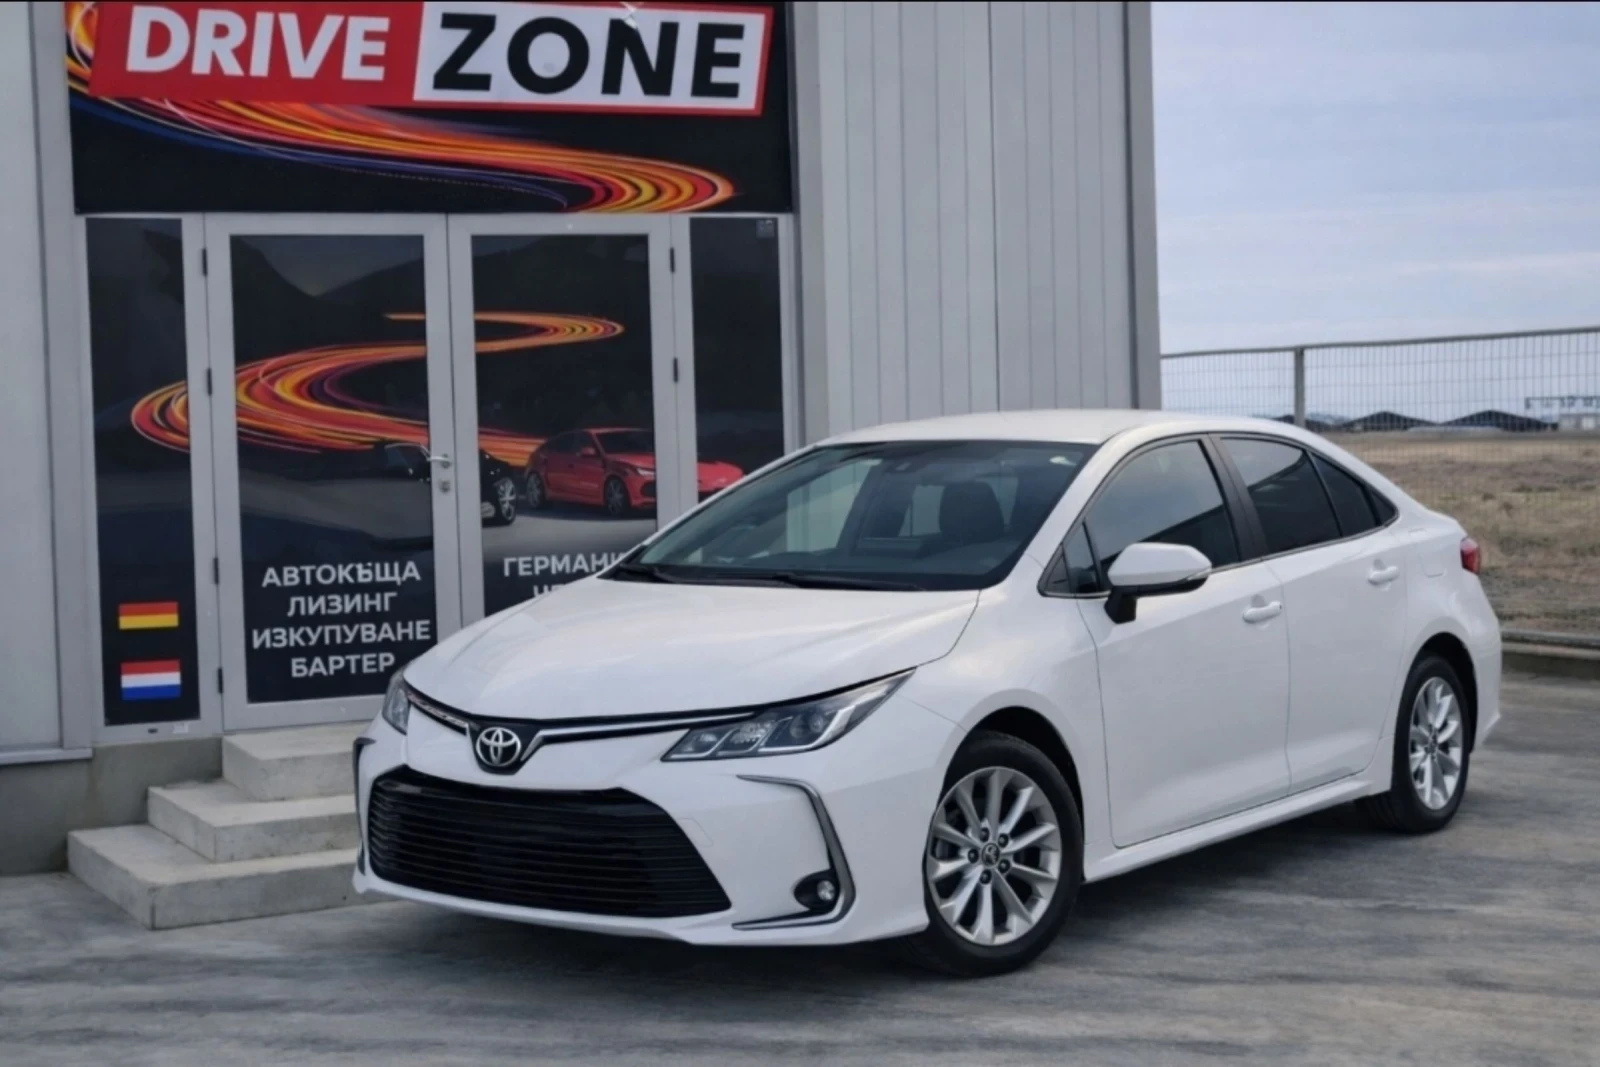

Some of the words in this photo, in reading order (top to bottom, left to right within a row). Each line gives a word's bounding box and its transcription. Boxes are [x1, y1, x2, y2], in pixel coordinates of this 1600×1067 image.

[126, 5, 390, 80] DRIVE
[433, 12, 745, 98] ZONE
[261, 561, 422, 588] АВТОКЪЩА
[287, 592, 398, 617] ЛИЗИНГ
[252, 620, 431, 649] ИЗКУПУВАНЕ
[291, 653, 395, 678] БАРТЕР
